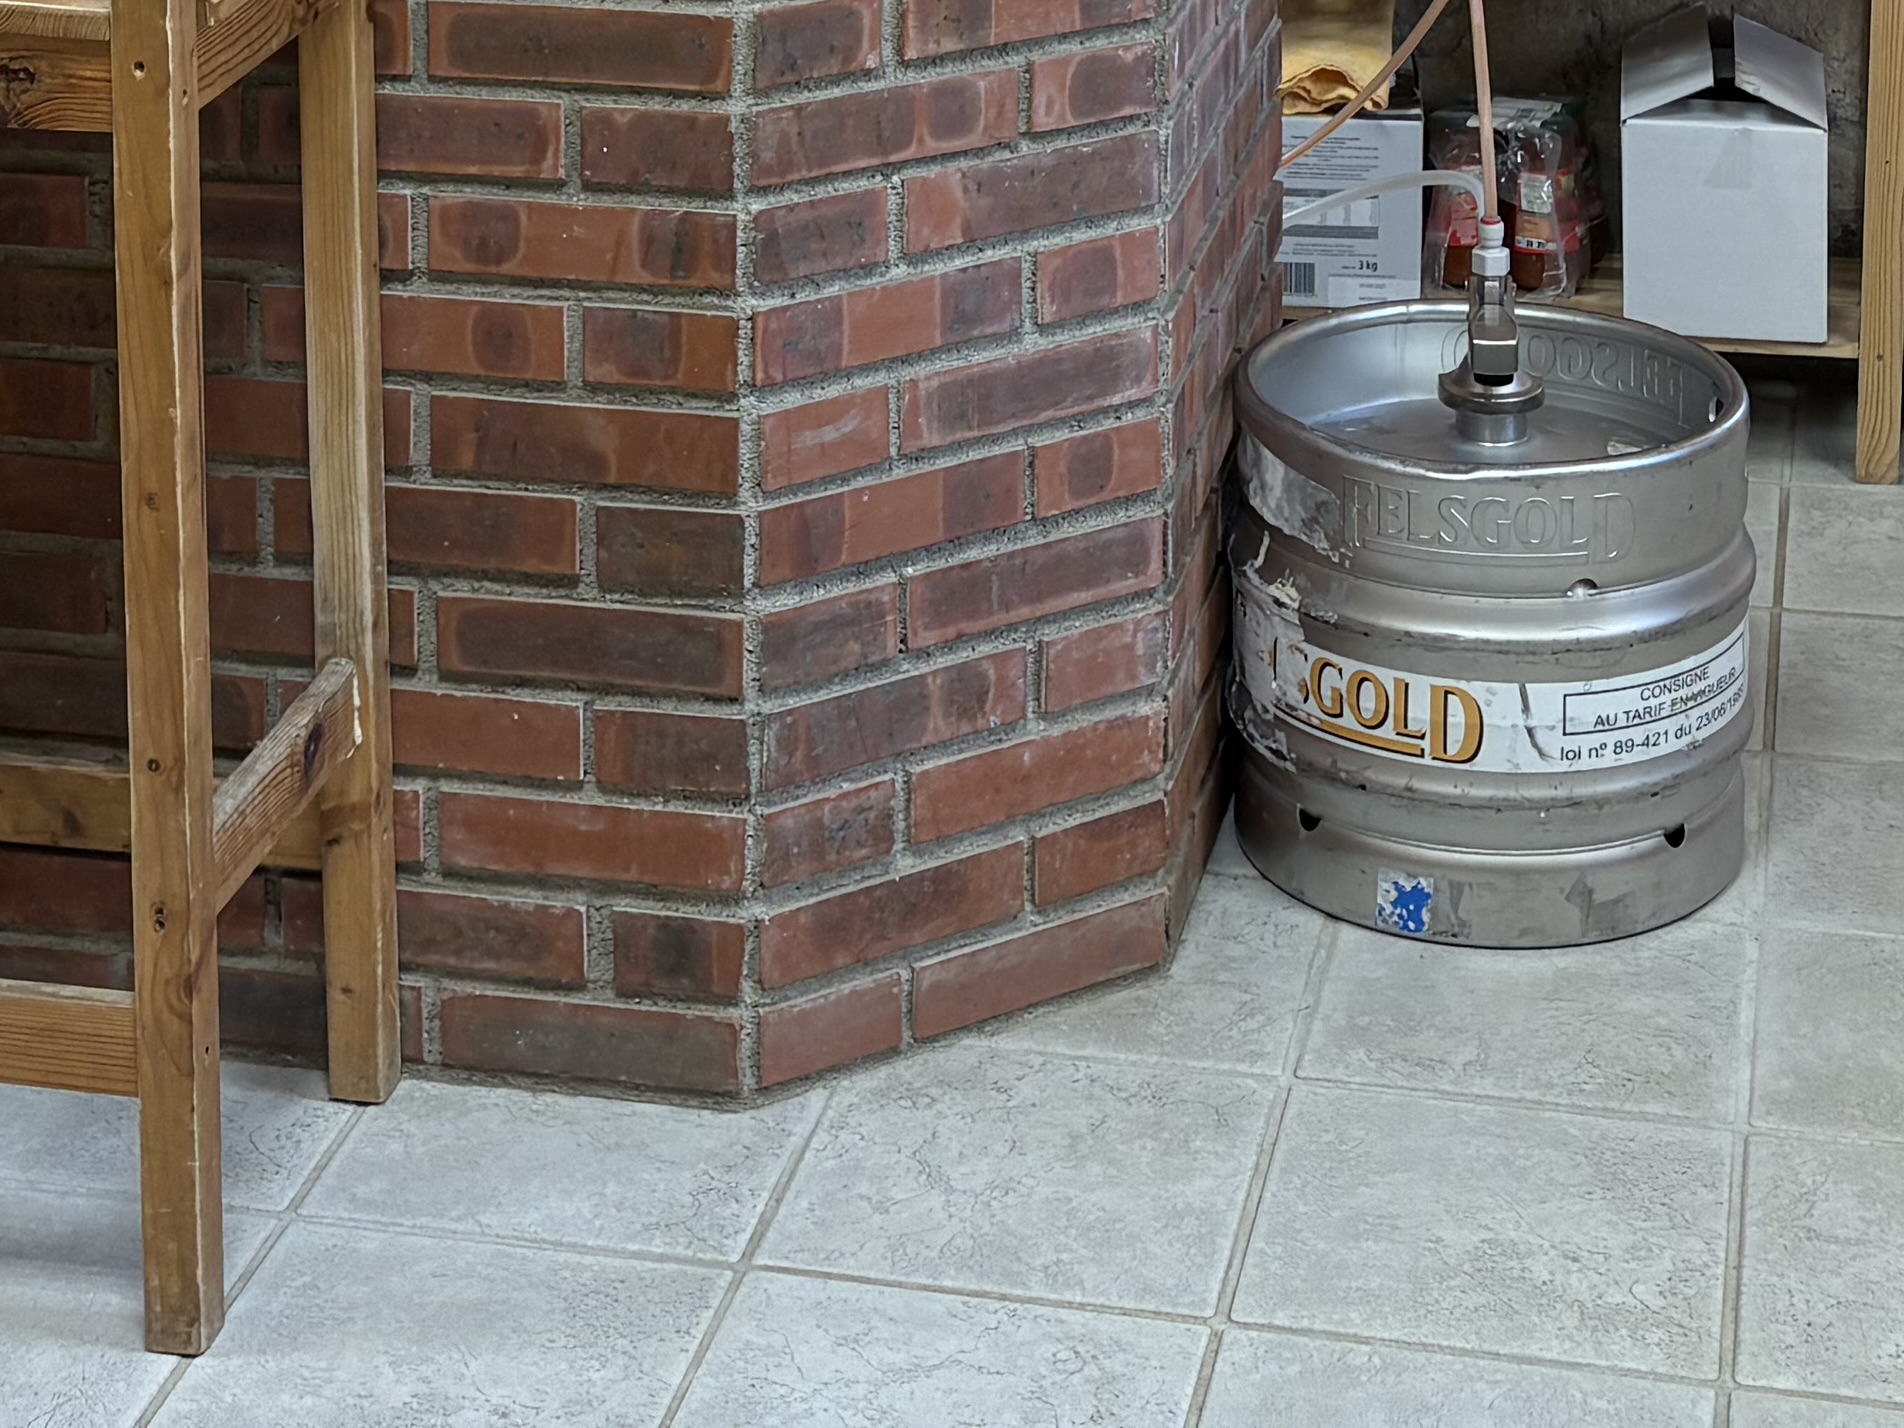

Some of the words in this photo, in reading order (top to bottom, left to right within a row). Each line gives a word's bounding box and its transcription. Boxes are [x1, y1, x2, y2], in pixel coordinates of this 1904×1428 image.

[1357, 260, 1364, 270] 3
[1365, 259, 1379, 272] kg
[1343, 473, 1637, 558] FELSGOLD
[1640, 666, 1710, 701] CONSIGNE
[1293, 652, 1484, 764] GOLD
[1593, 712, 1617, 729] AU
[1623, 701, 1667, 724] TARIF
[1560, 746, 1581, 762] loi
[1613, 730, 1669, 755] 89-421
[1674, 723, 1692, 741] du
